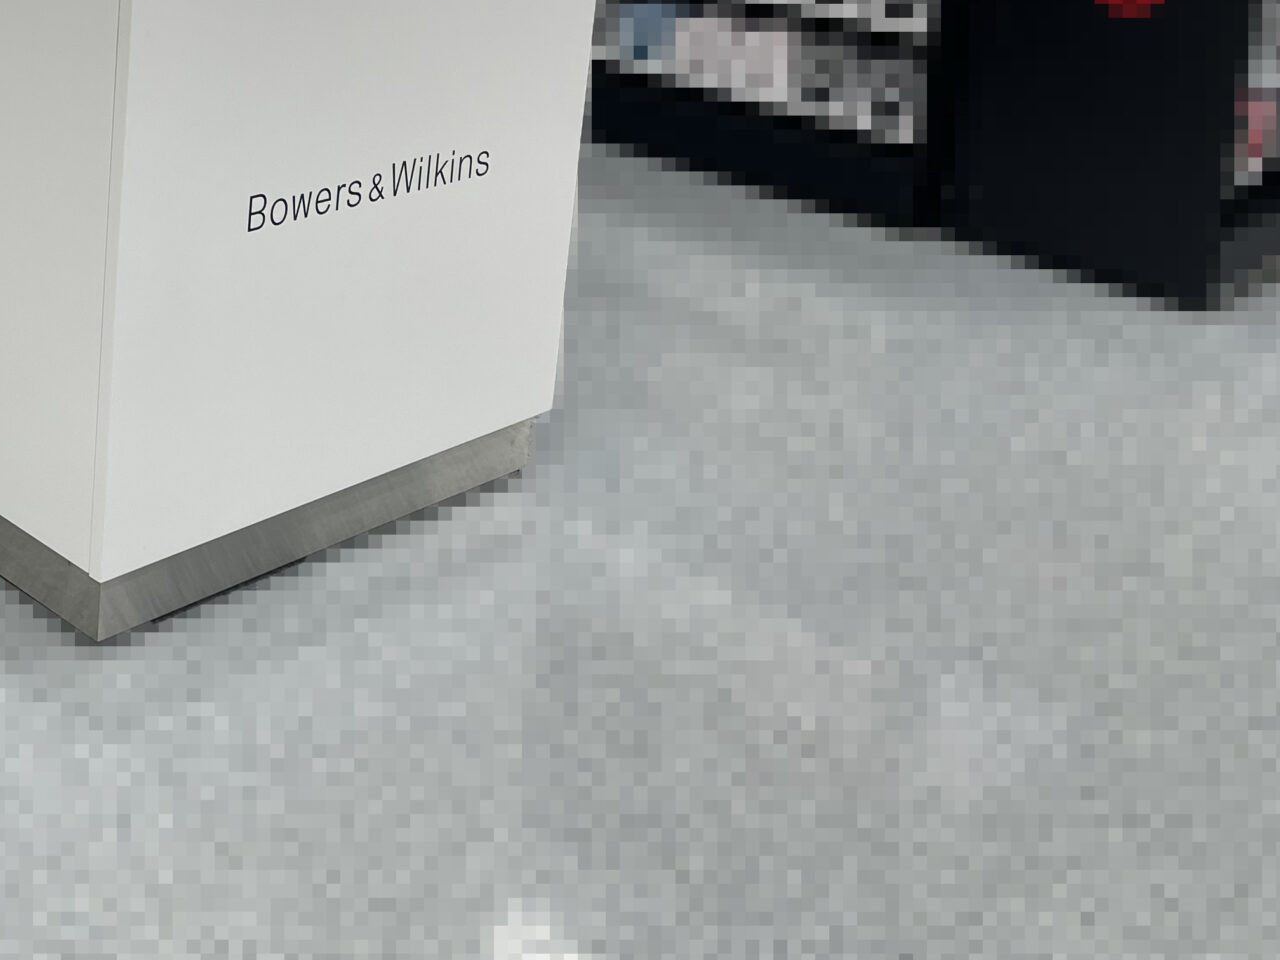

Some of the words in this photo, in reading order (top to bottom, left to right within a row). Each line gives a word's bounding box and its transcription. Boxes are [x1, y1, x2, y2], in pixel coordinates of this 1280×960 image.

[247, 179, 362, 233] Bowers
[368, 172, 385, 202] &
[391, 149, 490, 197] Wilkins
